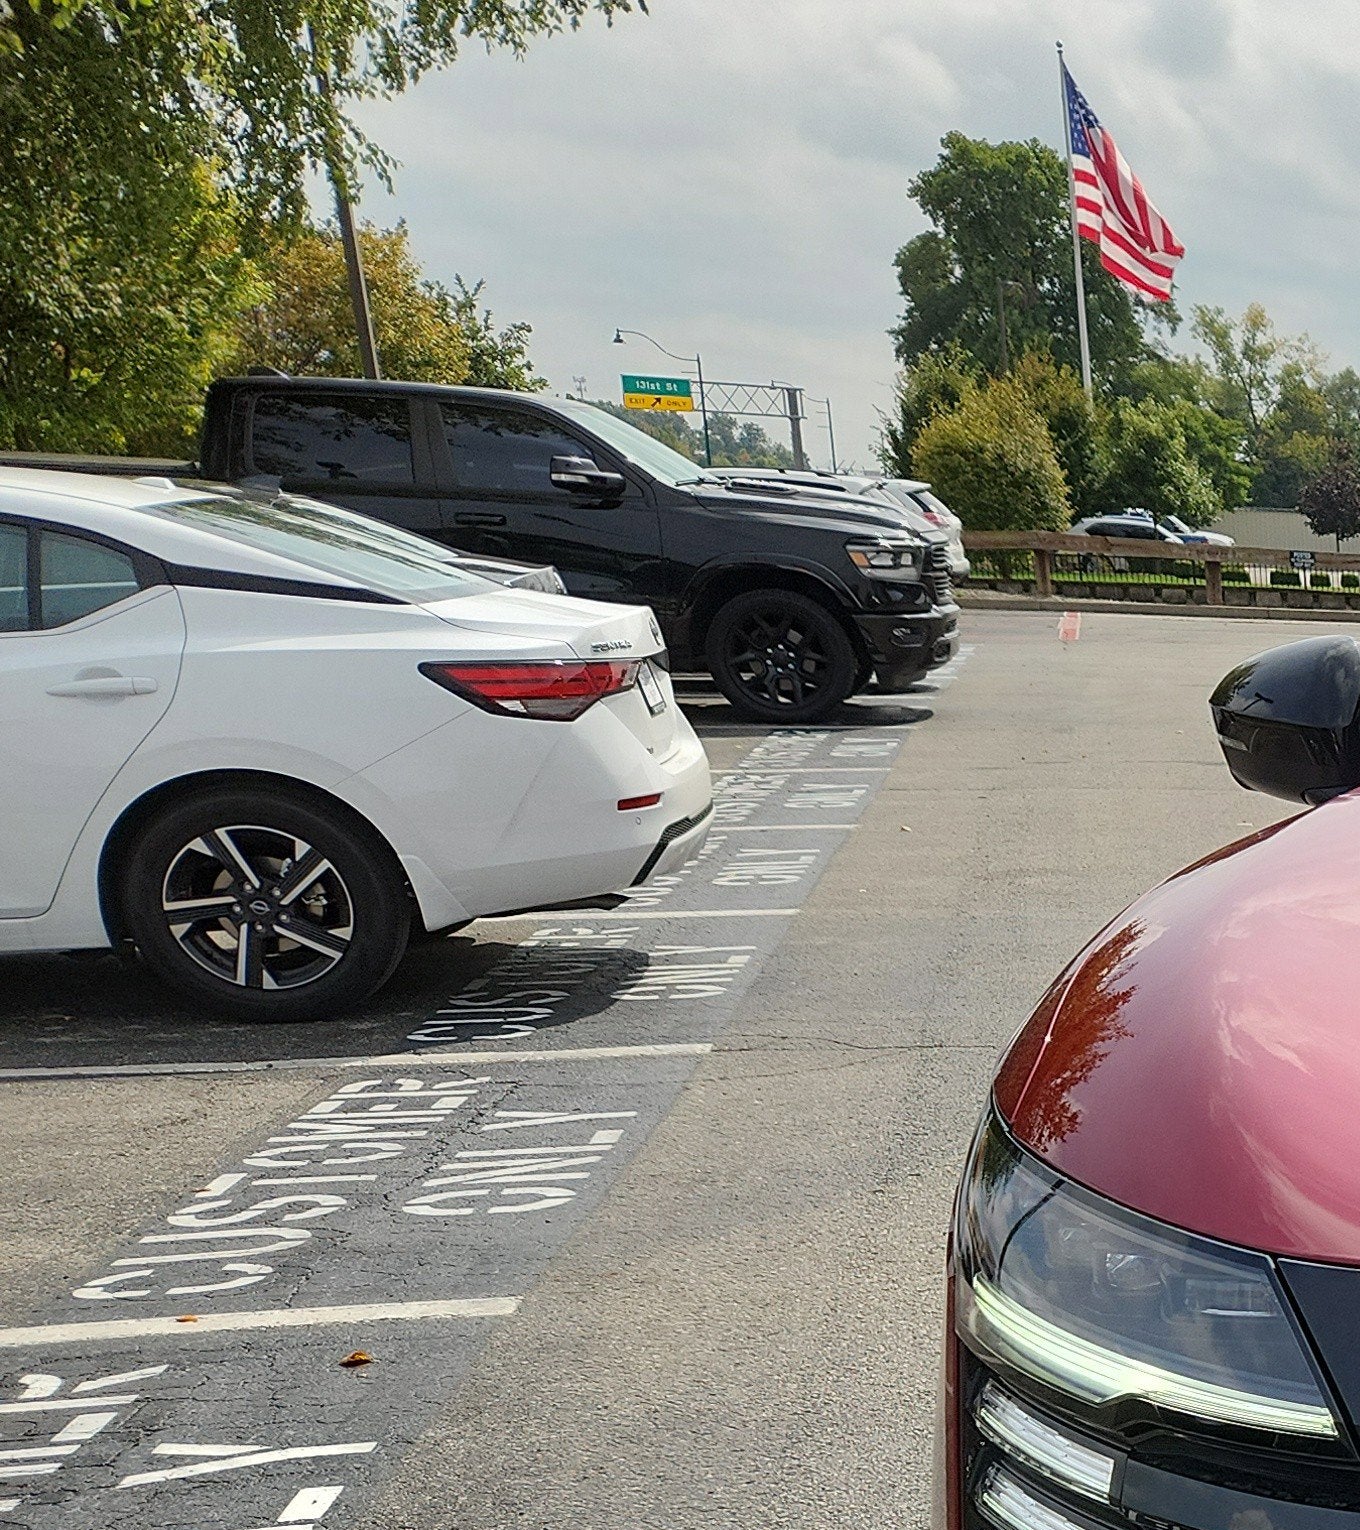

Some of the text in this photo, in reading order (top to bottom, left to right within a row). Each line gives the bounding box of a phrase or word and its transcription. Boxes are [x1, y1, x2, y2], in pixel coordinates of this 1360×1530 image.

[636, 380, 678, 391] 131st St
[712, 848, 821, 886] ONLY
[610, 944, 757, 1000] ONLY
[72, 1076, 491, 1299] CUSTOMER
[401, 1110, 638, 1216] ONLY
